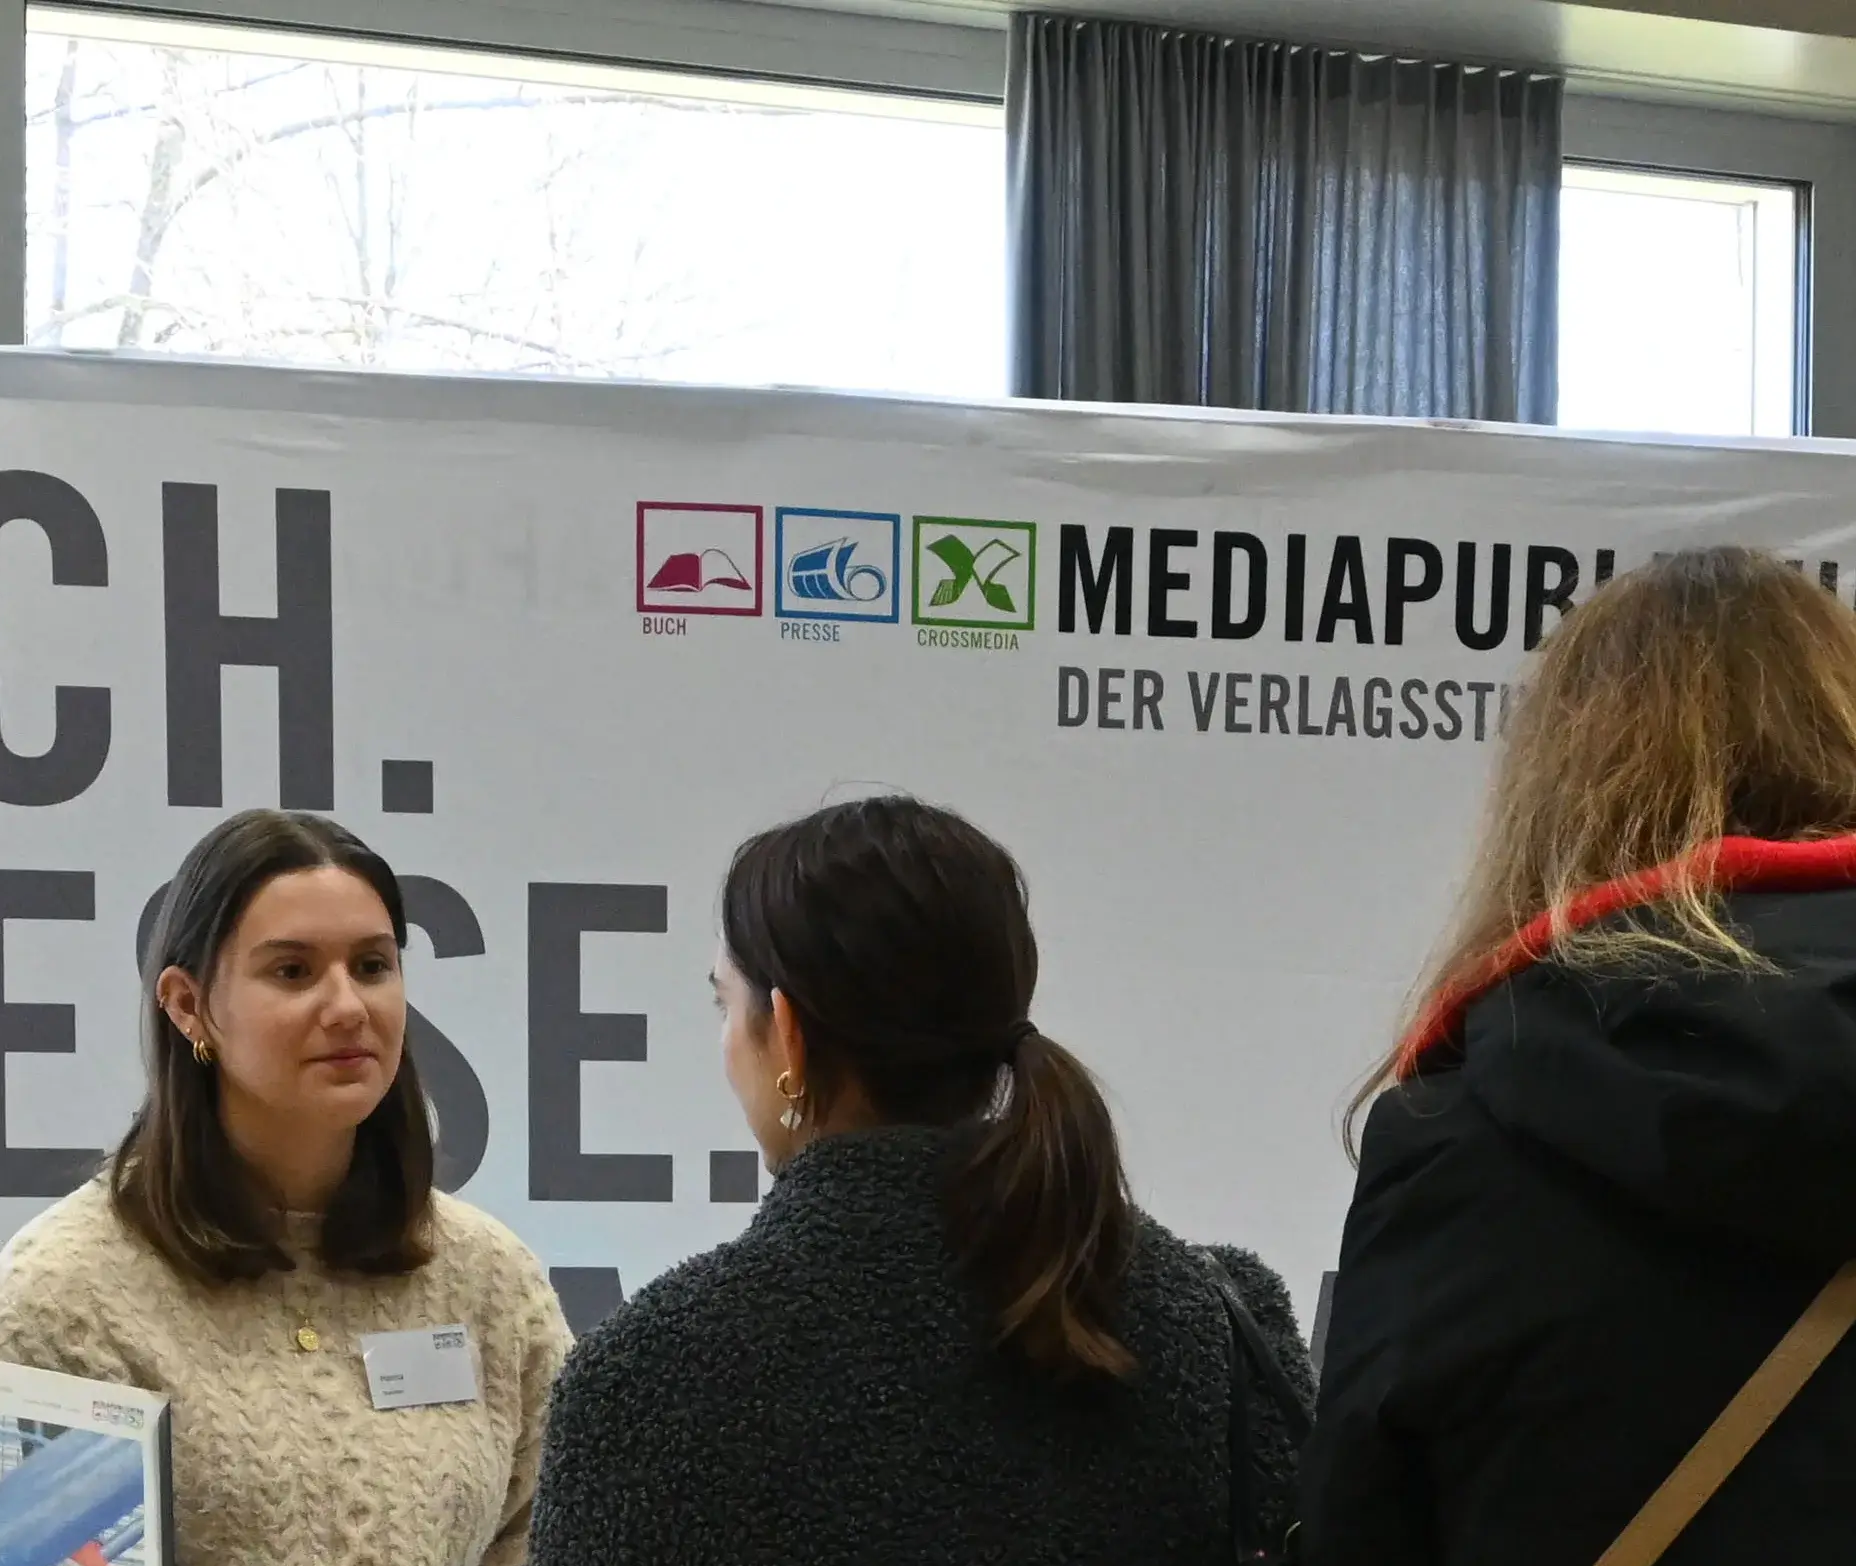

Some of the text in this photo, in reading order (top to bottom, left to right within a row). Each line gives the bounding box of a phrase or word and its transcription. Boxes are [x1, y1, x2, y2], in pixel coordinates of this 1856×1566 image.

[642, 617, 687, 636] BUCH
[780, 622, 841, 643] PRESSE
[917, 629, 1020, 651] CROSSMEDIA
[1057, 666, 1514, 742] DER VERLAGSST
